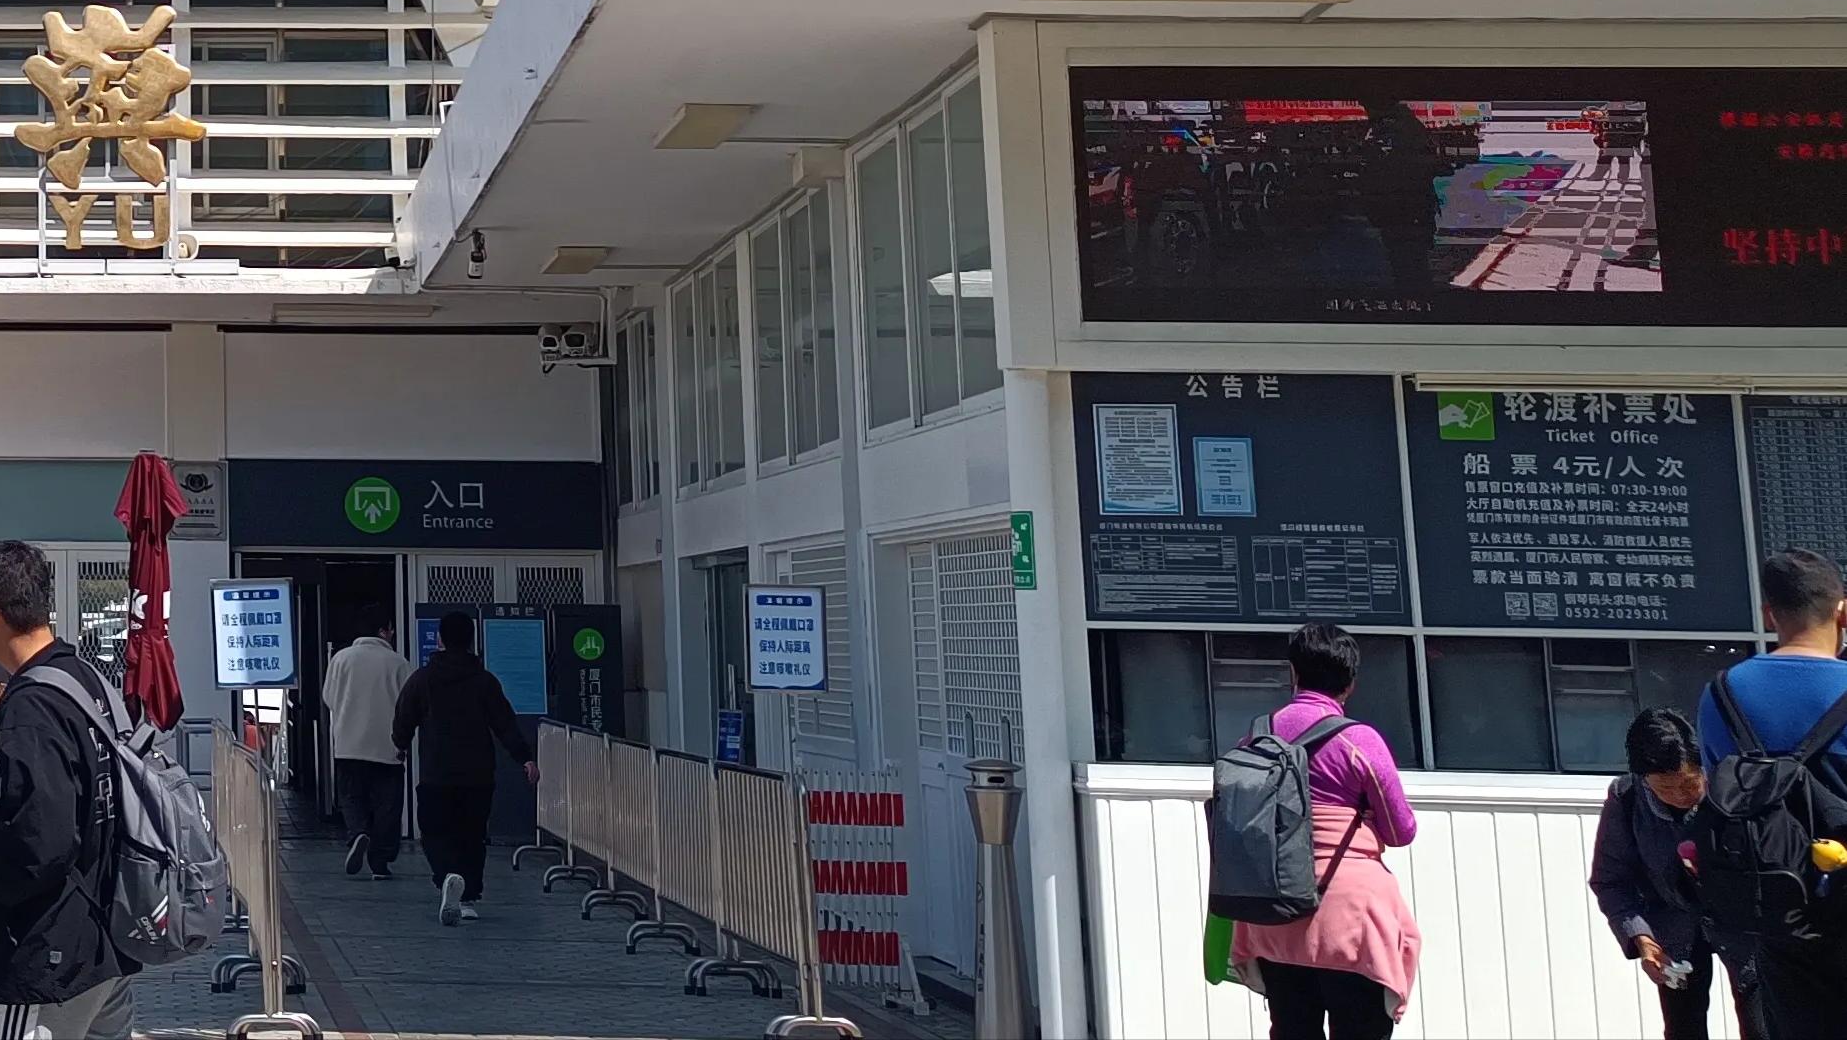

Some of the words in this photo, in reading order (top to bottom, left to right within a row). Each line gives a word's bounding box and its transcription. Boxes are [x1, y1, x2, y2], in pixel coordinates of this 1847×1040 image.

[48, 194, 171, 250] YU
[1186, 375, 1281, 399] 公告栏
[1503, 392, 1697, 425] 轮渡补票处
[1545, 429, 1595, 443] Ticket
[1610, 430, 1659, 444] Office
[423, 480, 484, 509] 入口
[423, 514, 494, 528] Entrance
[1565, 607, 1668, 620] 0592-2029301
